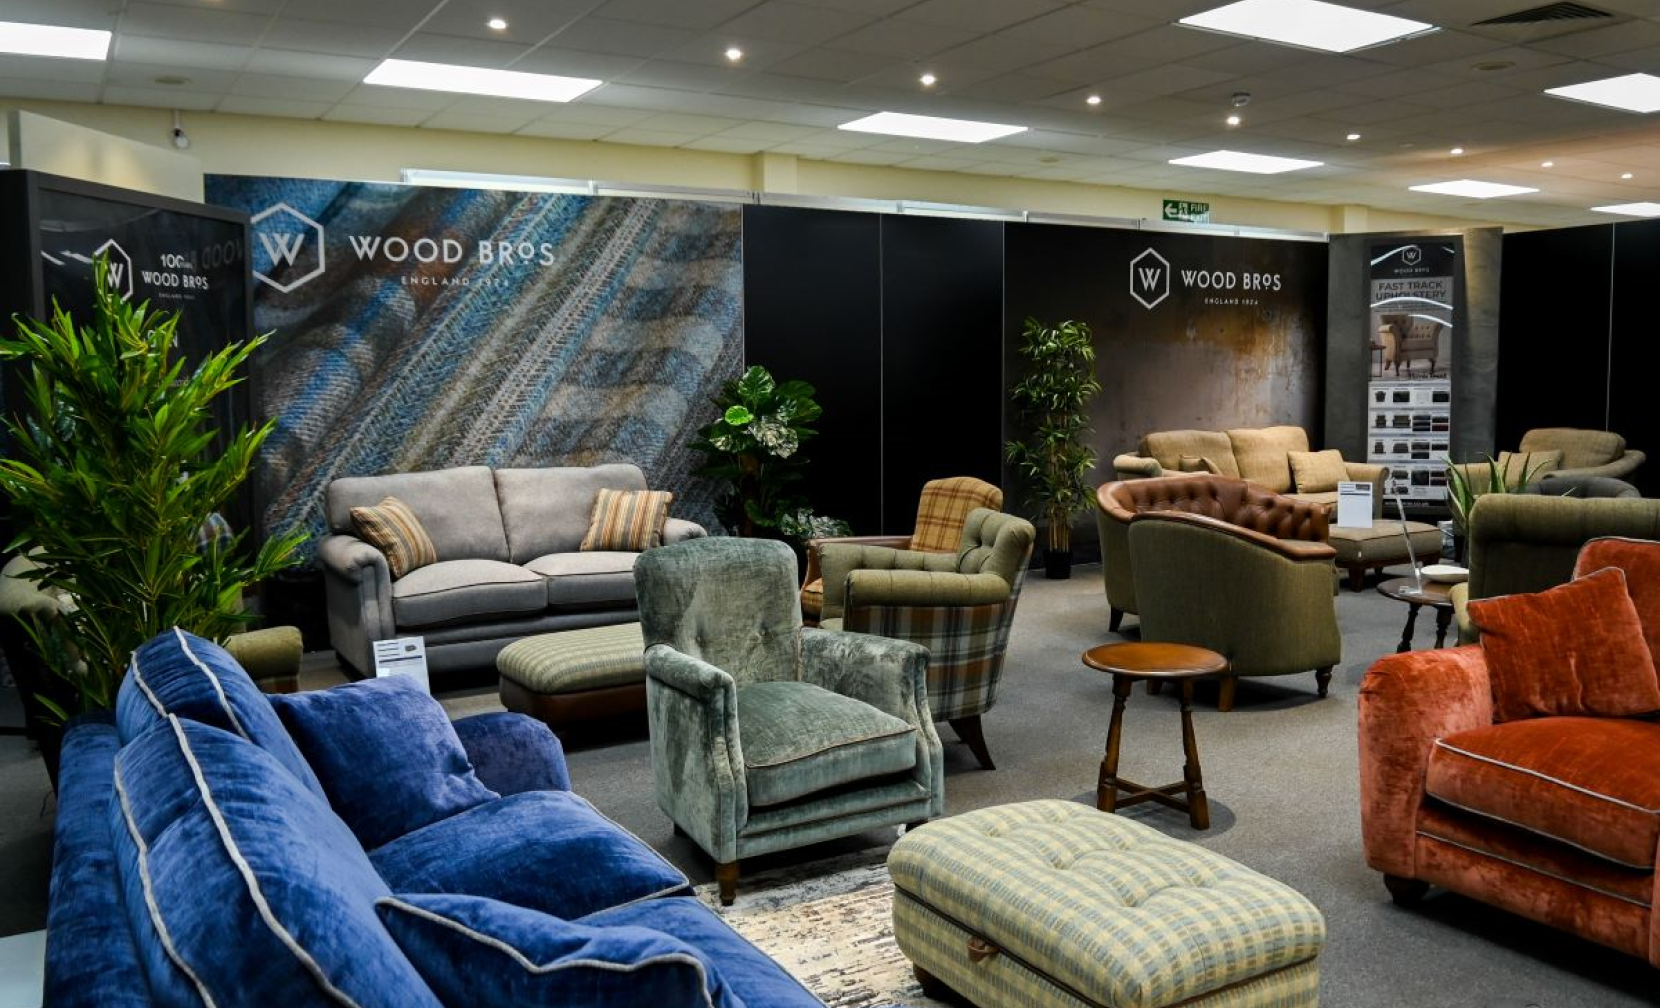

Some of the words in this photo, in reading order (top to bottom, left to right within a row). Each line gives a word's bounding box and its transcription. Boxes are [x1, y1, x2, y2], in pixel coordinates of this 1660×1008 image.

[259, 232, 305, 267] W
[349, 235, 463, 263] WOOD
[141, 270, 180, 288] WOOD
[401, 276, 470, 286] ENGLAND
[1138, 267, 1162, 292] W
[1181, 269, 1236, 290] WOOD
[1378, 282, 1404, 291] FAST
[1408, 281, 1444, 290] TRACK
[1204, 297, 1239, 305] ENGLAND
